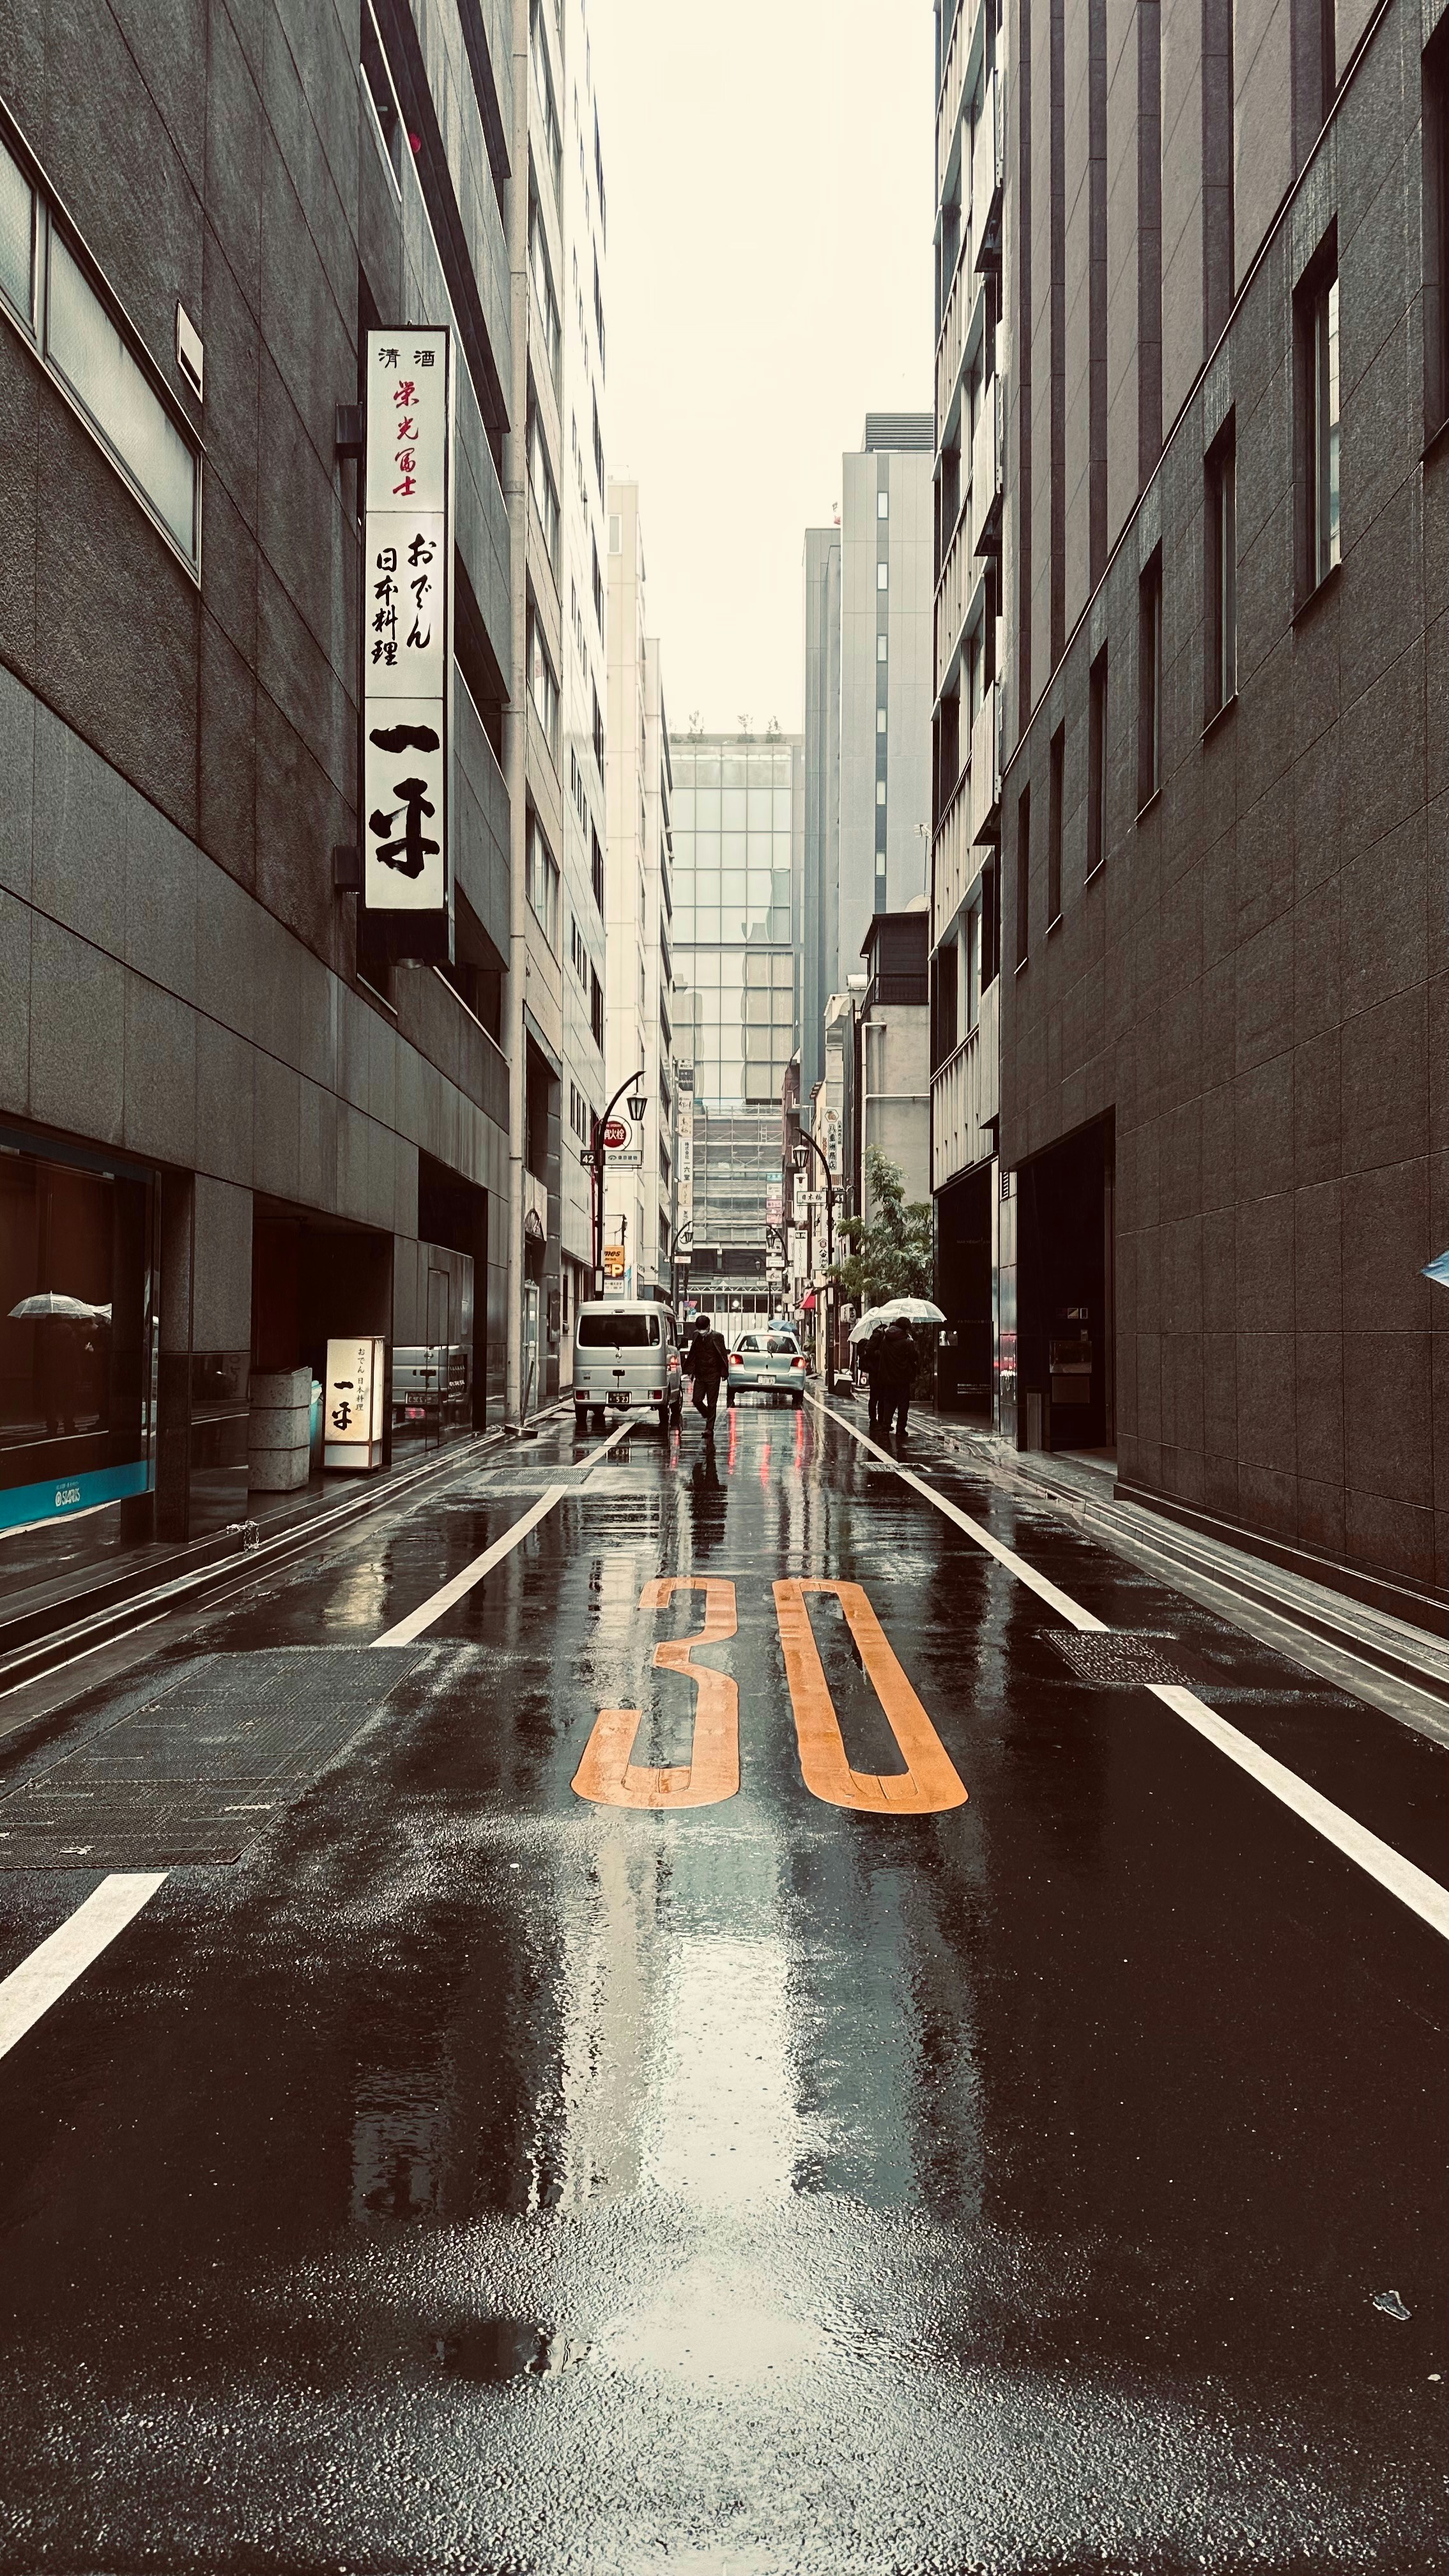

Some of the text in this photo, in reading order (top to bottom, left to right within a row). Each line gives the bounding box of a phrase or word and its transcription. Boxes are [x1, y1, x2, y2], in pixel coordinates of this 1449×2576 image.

[378, 348, 436, 369] 清酒
[371, 548, 399, 666] 日本料理
[407, 533, 437, 650] おでん
[369, 724, 441, 880] 一平
[582, 1154, 594, 1163] 42
[612, 1264, 624, 1277] P
[331, 1381, 354, 1431] 一平
[355, 1347, 365, 1411] おでん 日本料理
[571, 1577, 969, 1814] 30
